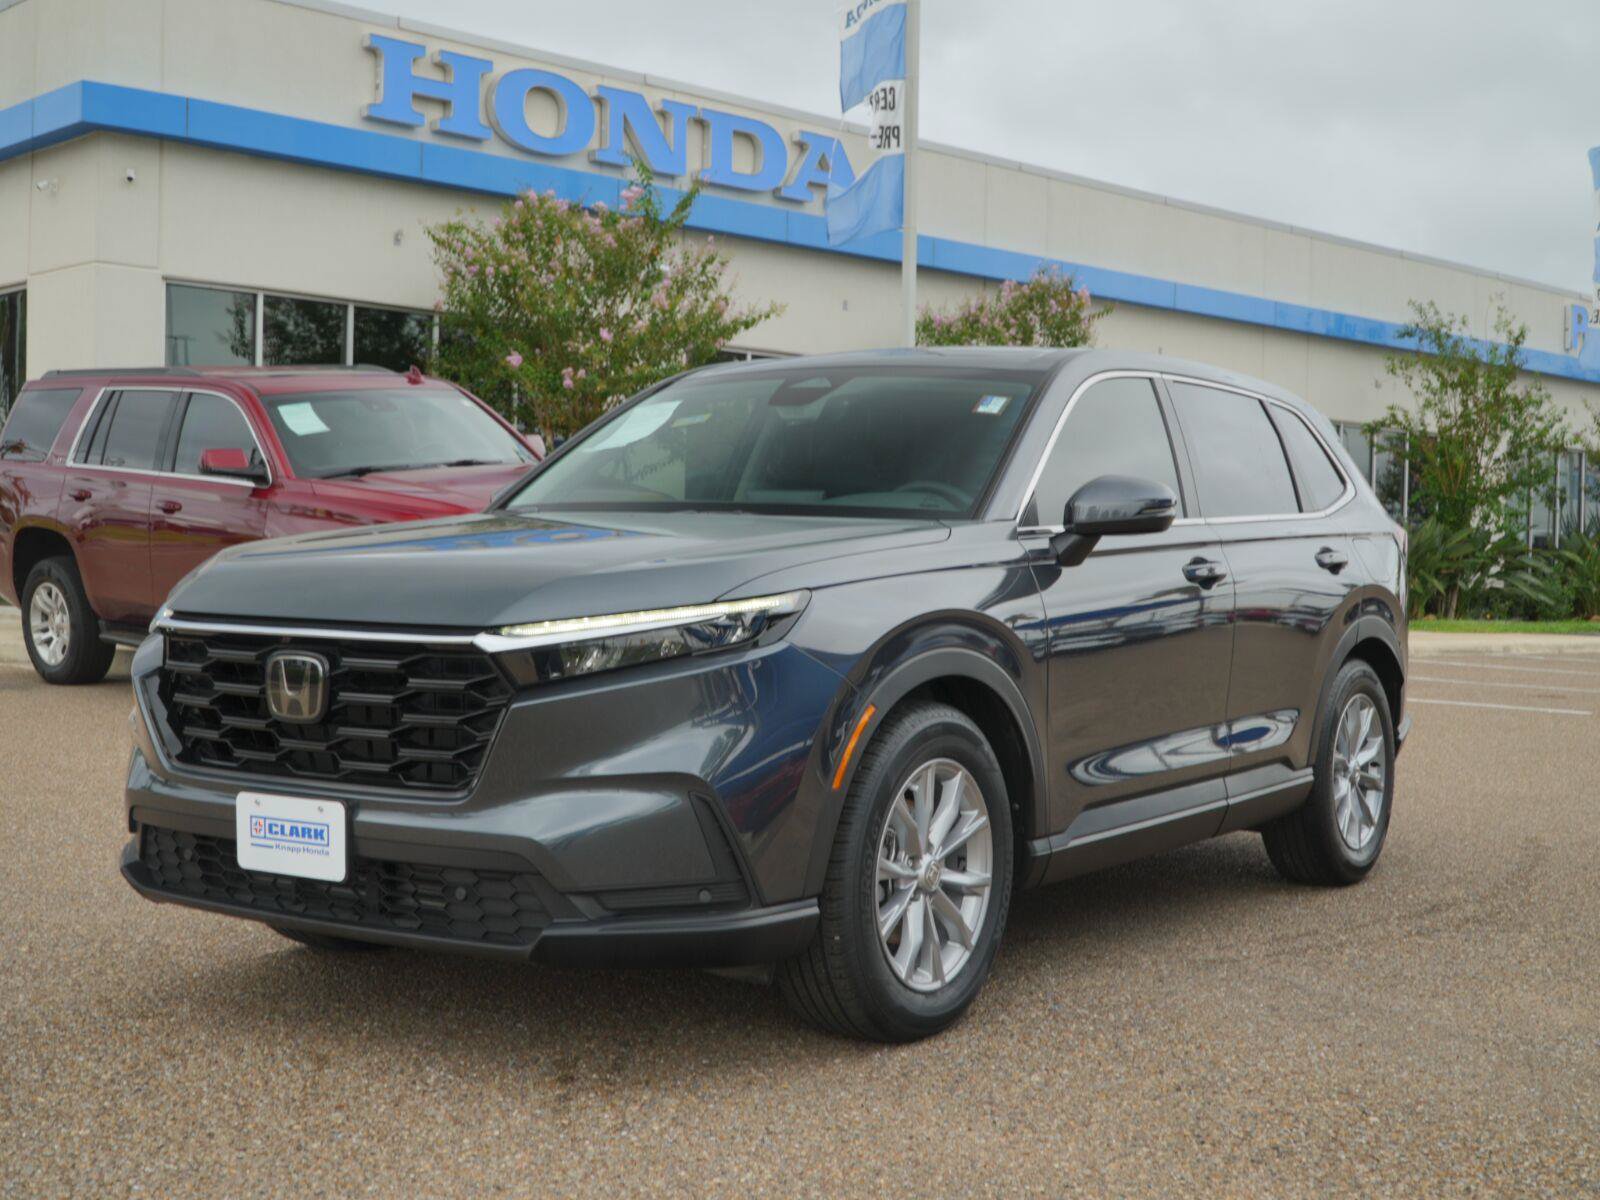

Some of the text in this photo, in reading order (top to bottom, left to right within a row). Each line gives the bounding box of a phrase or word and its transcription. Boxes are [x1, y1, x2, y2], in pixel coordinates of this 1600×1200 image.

[364, 33, 856, 203] HONDA
[268, 822, 325, 841] CLARK
[275, 843, 329, 856] Knapp Honda
